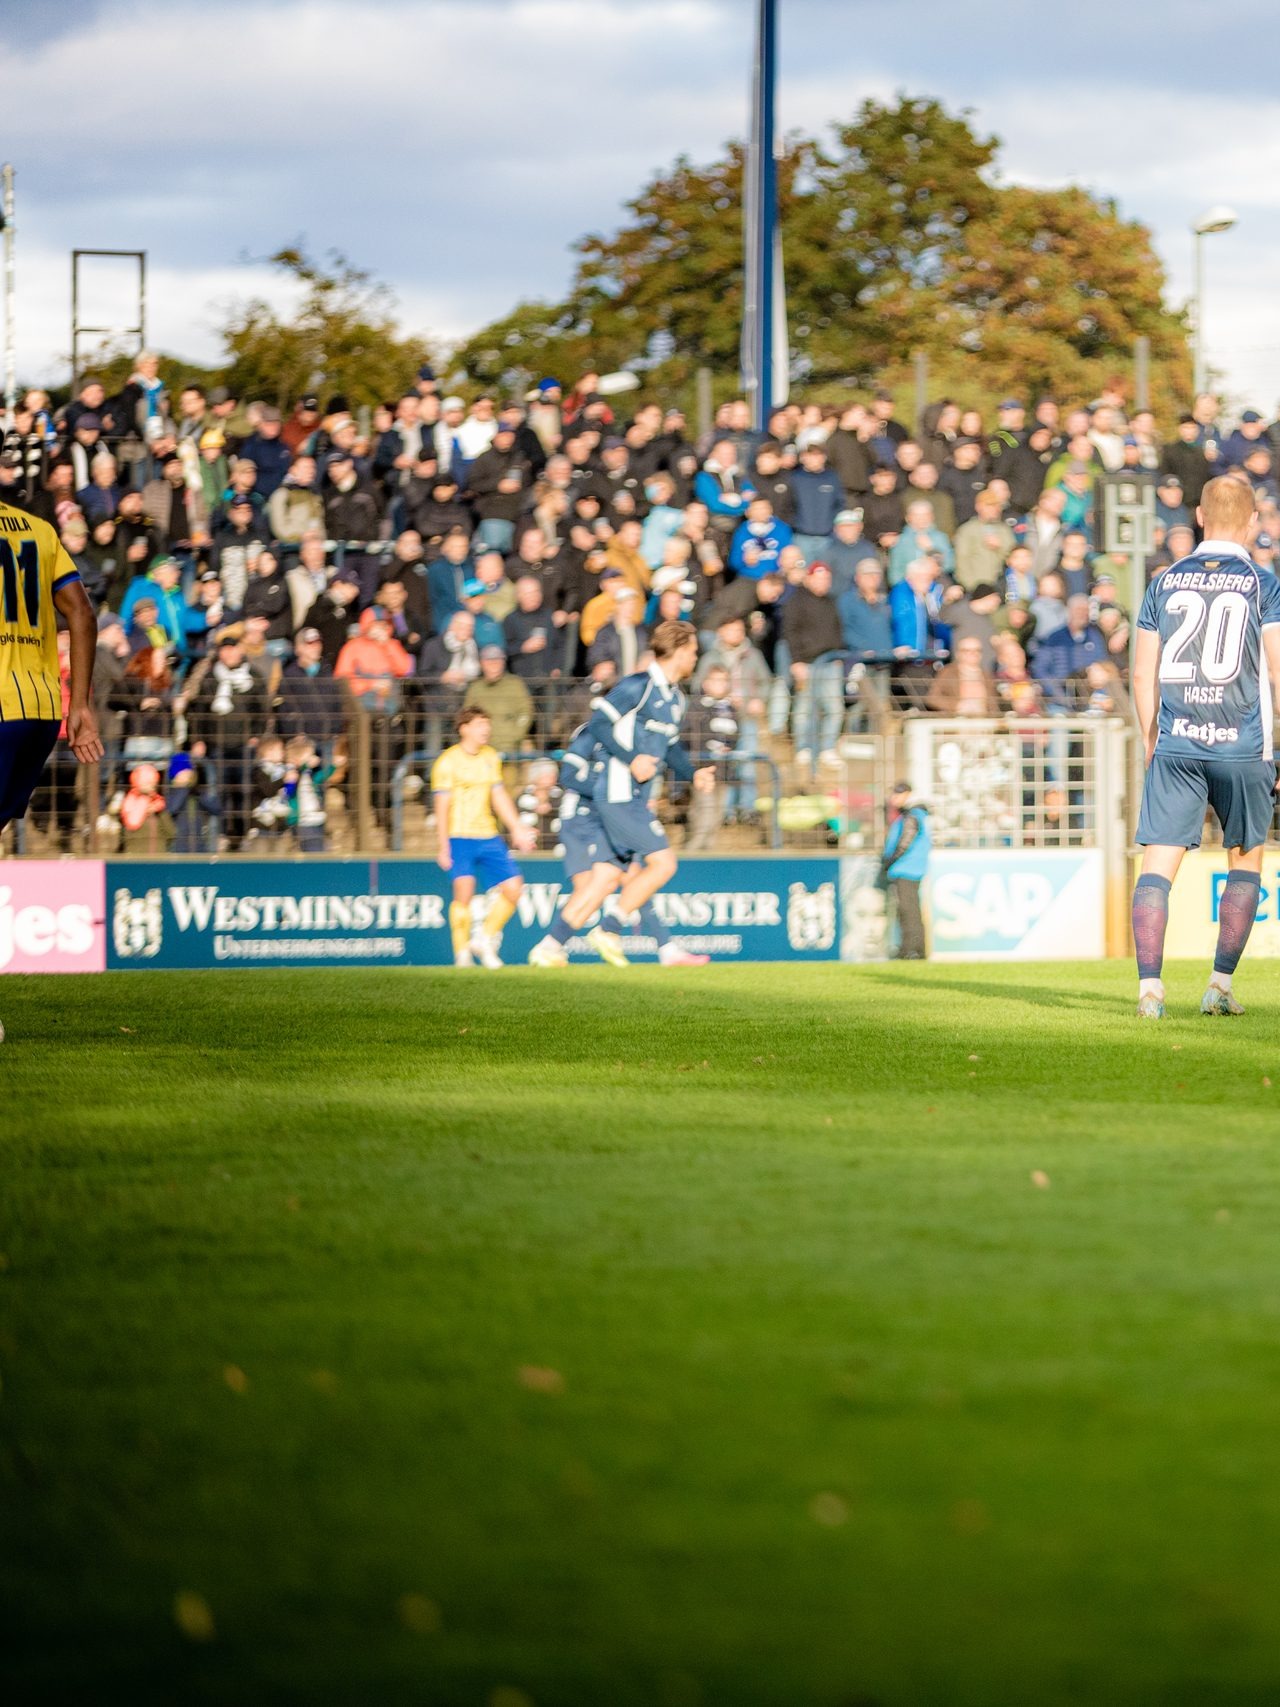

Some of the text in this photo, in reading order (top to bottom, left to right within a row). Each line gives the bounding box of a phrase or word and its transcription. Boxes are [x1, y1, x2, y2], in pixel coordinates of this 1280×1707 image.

[0, 516, 32, 532] TULA
[1163, 572, 1255, 593] BABELSBERG
[1159, 590, 1249, 684] 20
[1184, 686, 1224, 704] HASSE
[1171, 718, 1239, 745] Katjes
[168, 886, 447, 932] WESTMINSTER
[934, 872, 1052, 940] SAP
